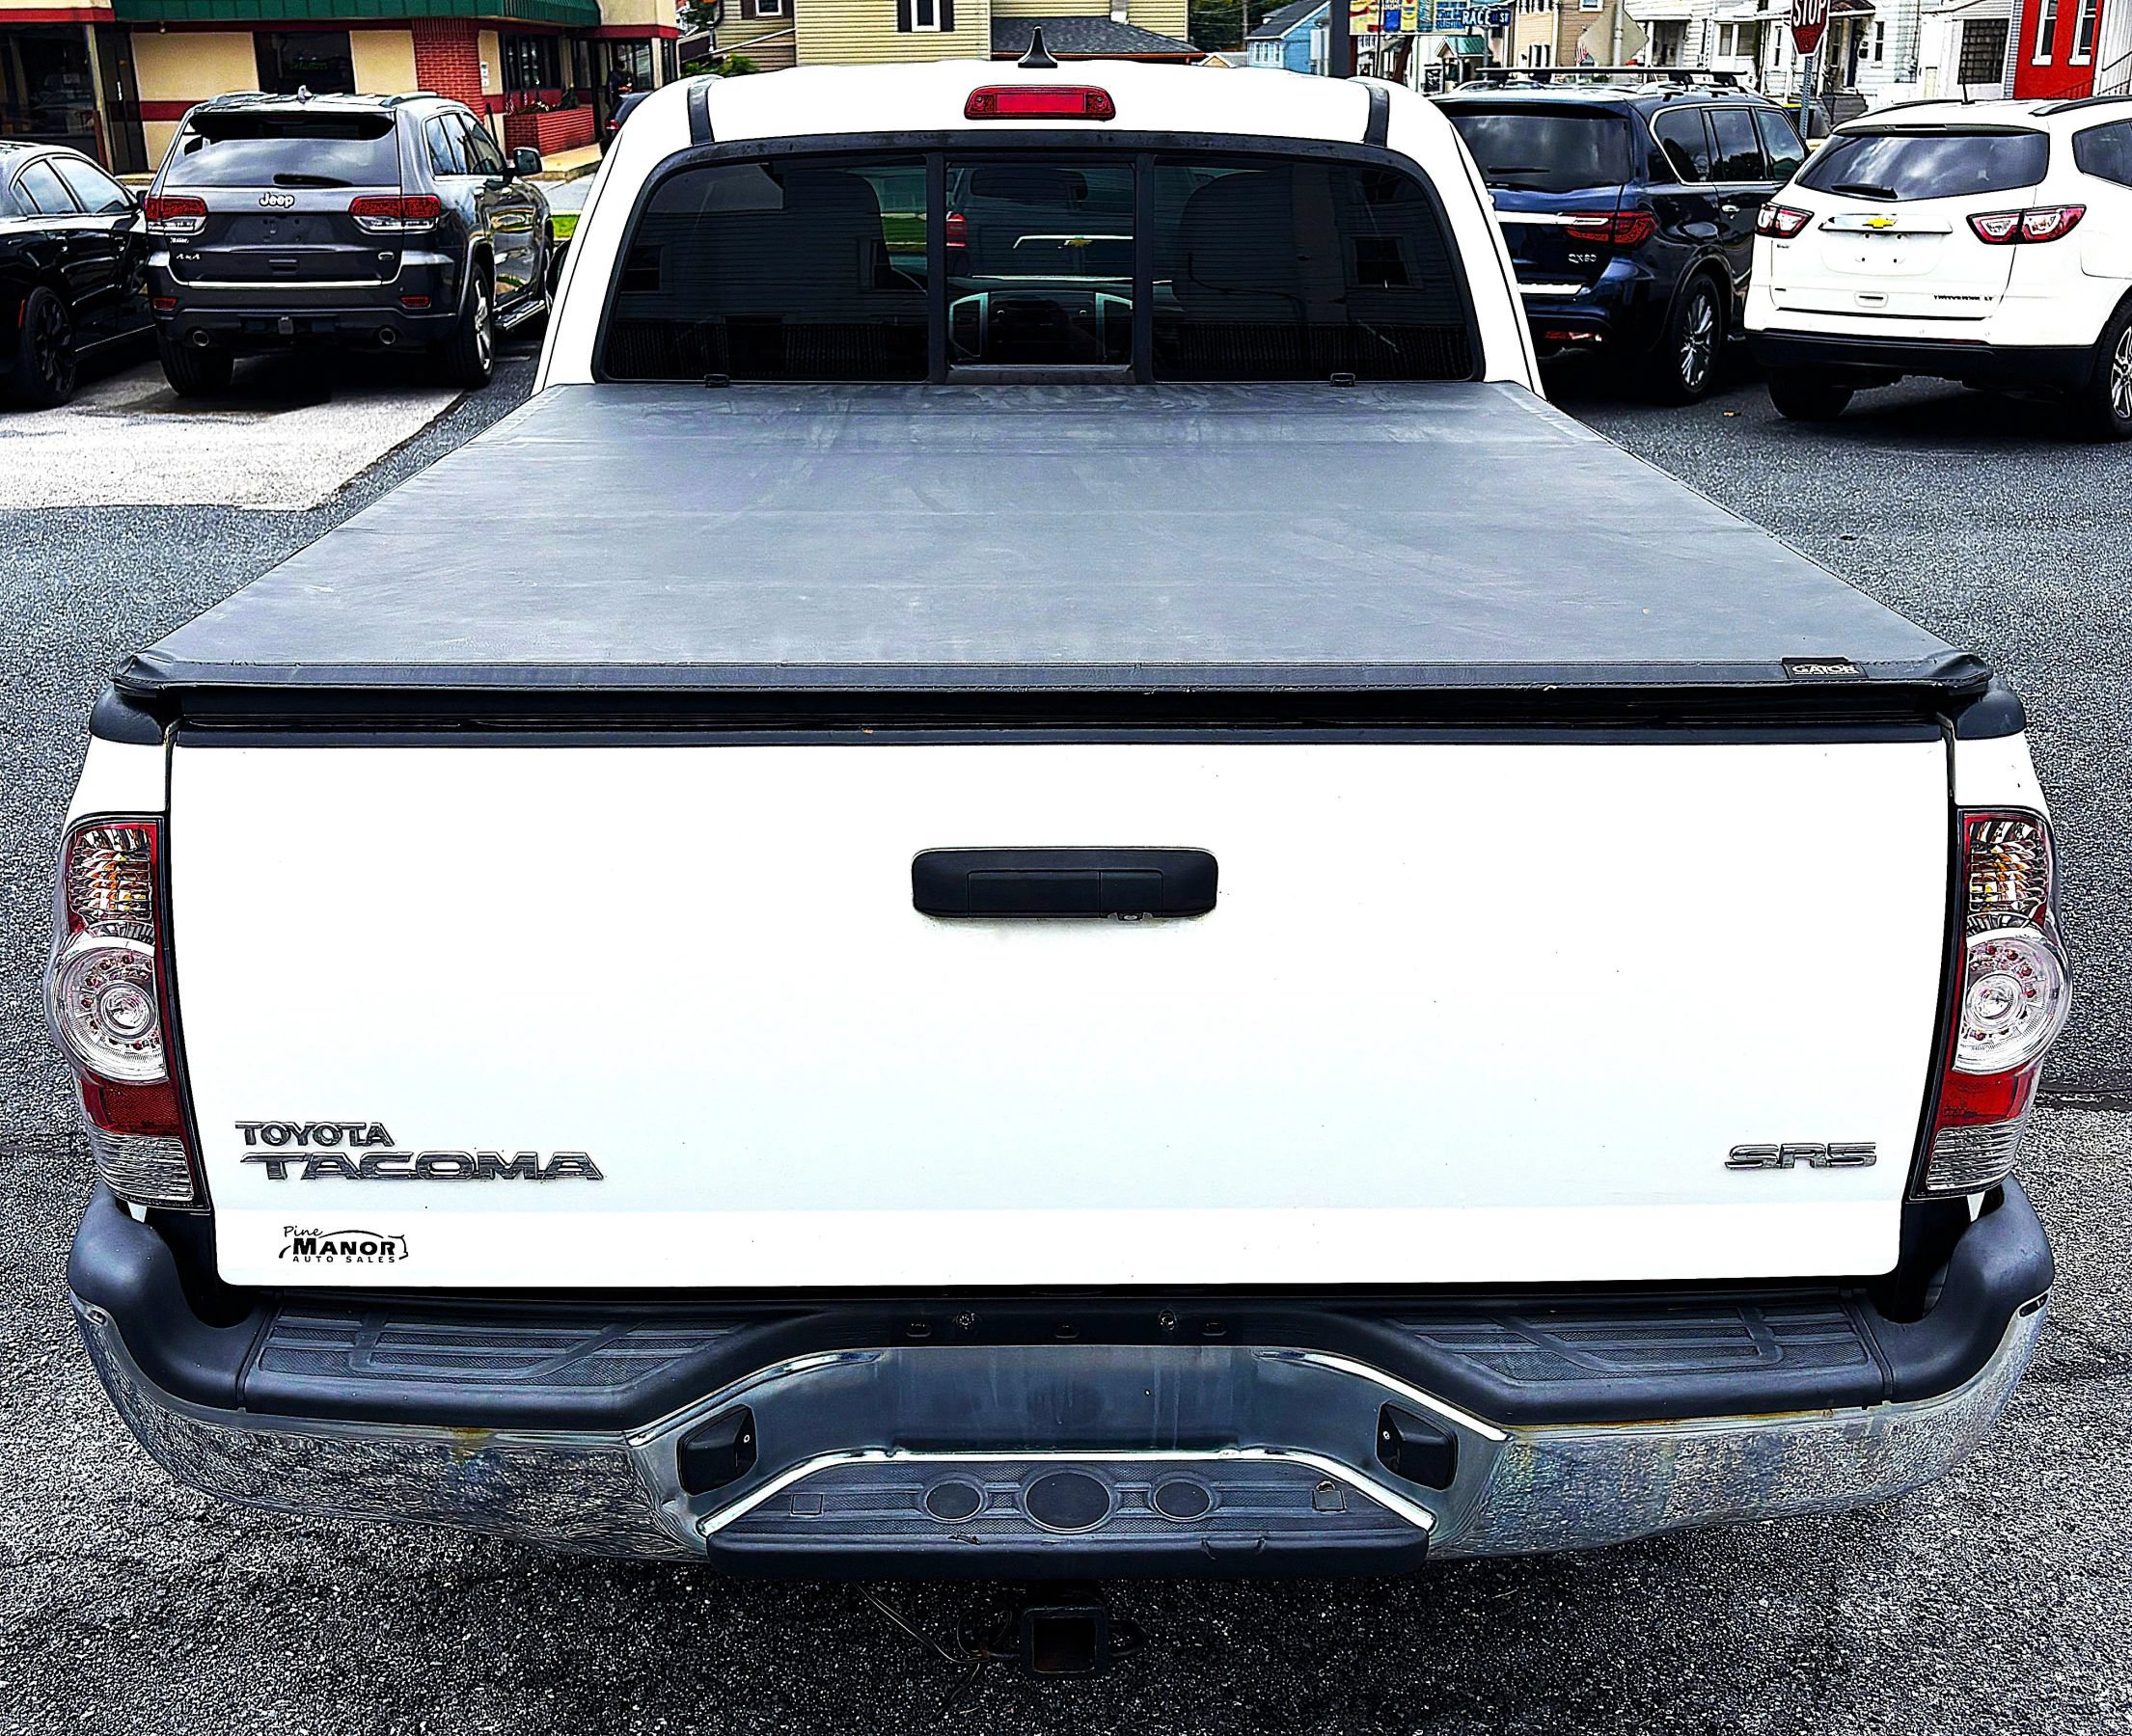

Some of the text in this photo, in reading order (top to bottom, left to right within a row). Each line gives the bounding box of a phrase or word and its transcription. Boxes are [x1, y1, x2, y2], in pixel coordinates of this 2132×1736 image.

[1462, 10, 1491, 25] RACE
[1499, 13, 1510, 23] ST
[1793, 0, 1827, 27] STOP
[259, 192, 295, 208] Jeep
[1791, 664, 1860, 675] GATOR
[234, 1121, 396, 1147] TOYOTA
[1724, 1142, 1877, 1169] SR5
[240, 1151, 605, 1181] TACOMA
[283, 1225, 323, 1237] Pine
[292, 1237, 396, 1256] MANOR
